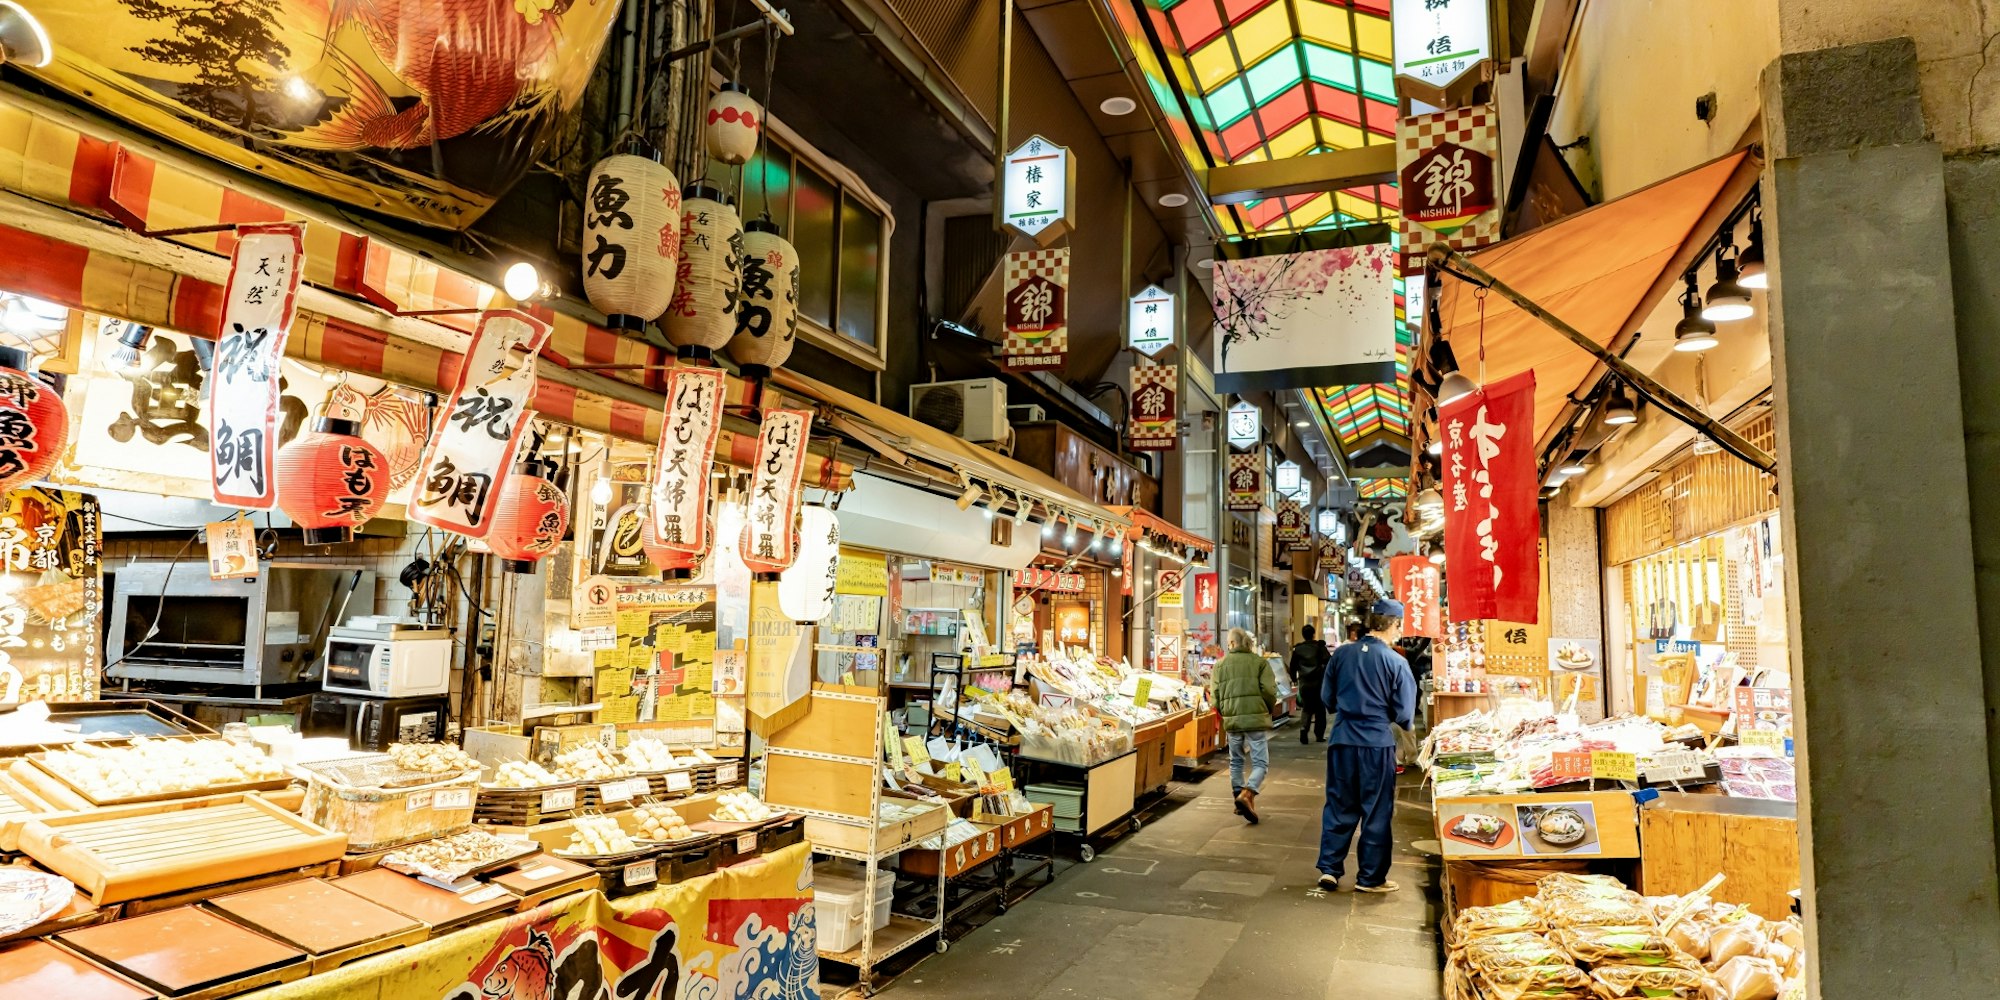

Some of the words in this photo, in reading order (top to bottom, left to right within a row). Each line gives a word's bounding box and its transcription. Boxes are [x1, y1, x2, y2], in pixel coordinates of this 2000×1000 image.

[1422, 59, 1465, 77] 京漬物
[1025, 165, 1044, 208] 椿家
[1413, 149, 1475, 217] 錦
[587, 174, 634, 280] 魚力
[692, 211, 711, 251] 名代
[1420, 208, 1456, 218] NISHIKI
[245, 257, 271, 304] 天然
[766, 250, 783, 269] 錦
[1014, 281, 1053, 330] 錦
[1008, 355, 1062, 366] 錦市場商店街
[215, 322, 270, 496] 祝鯛
[1136, 386, 1166, 420] 錦
[417, 385, 514, 526] 祝鯛
[662, 382, 704, 544] はも天婦羅
[1448, 418, 1468, 512] 京名産
[324, 445, 379, 521] はも天
[755, 420, 791, 560] はも天婦羅
[83, 501, 97, 565] 創業大正8年
[522, 482, 563, 552] 錦魚力
[33, 523, 60, 570] 京都
[50, 616, 68, 652] はも
